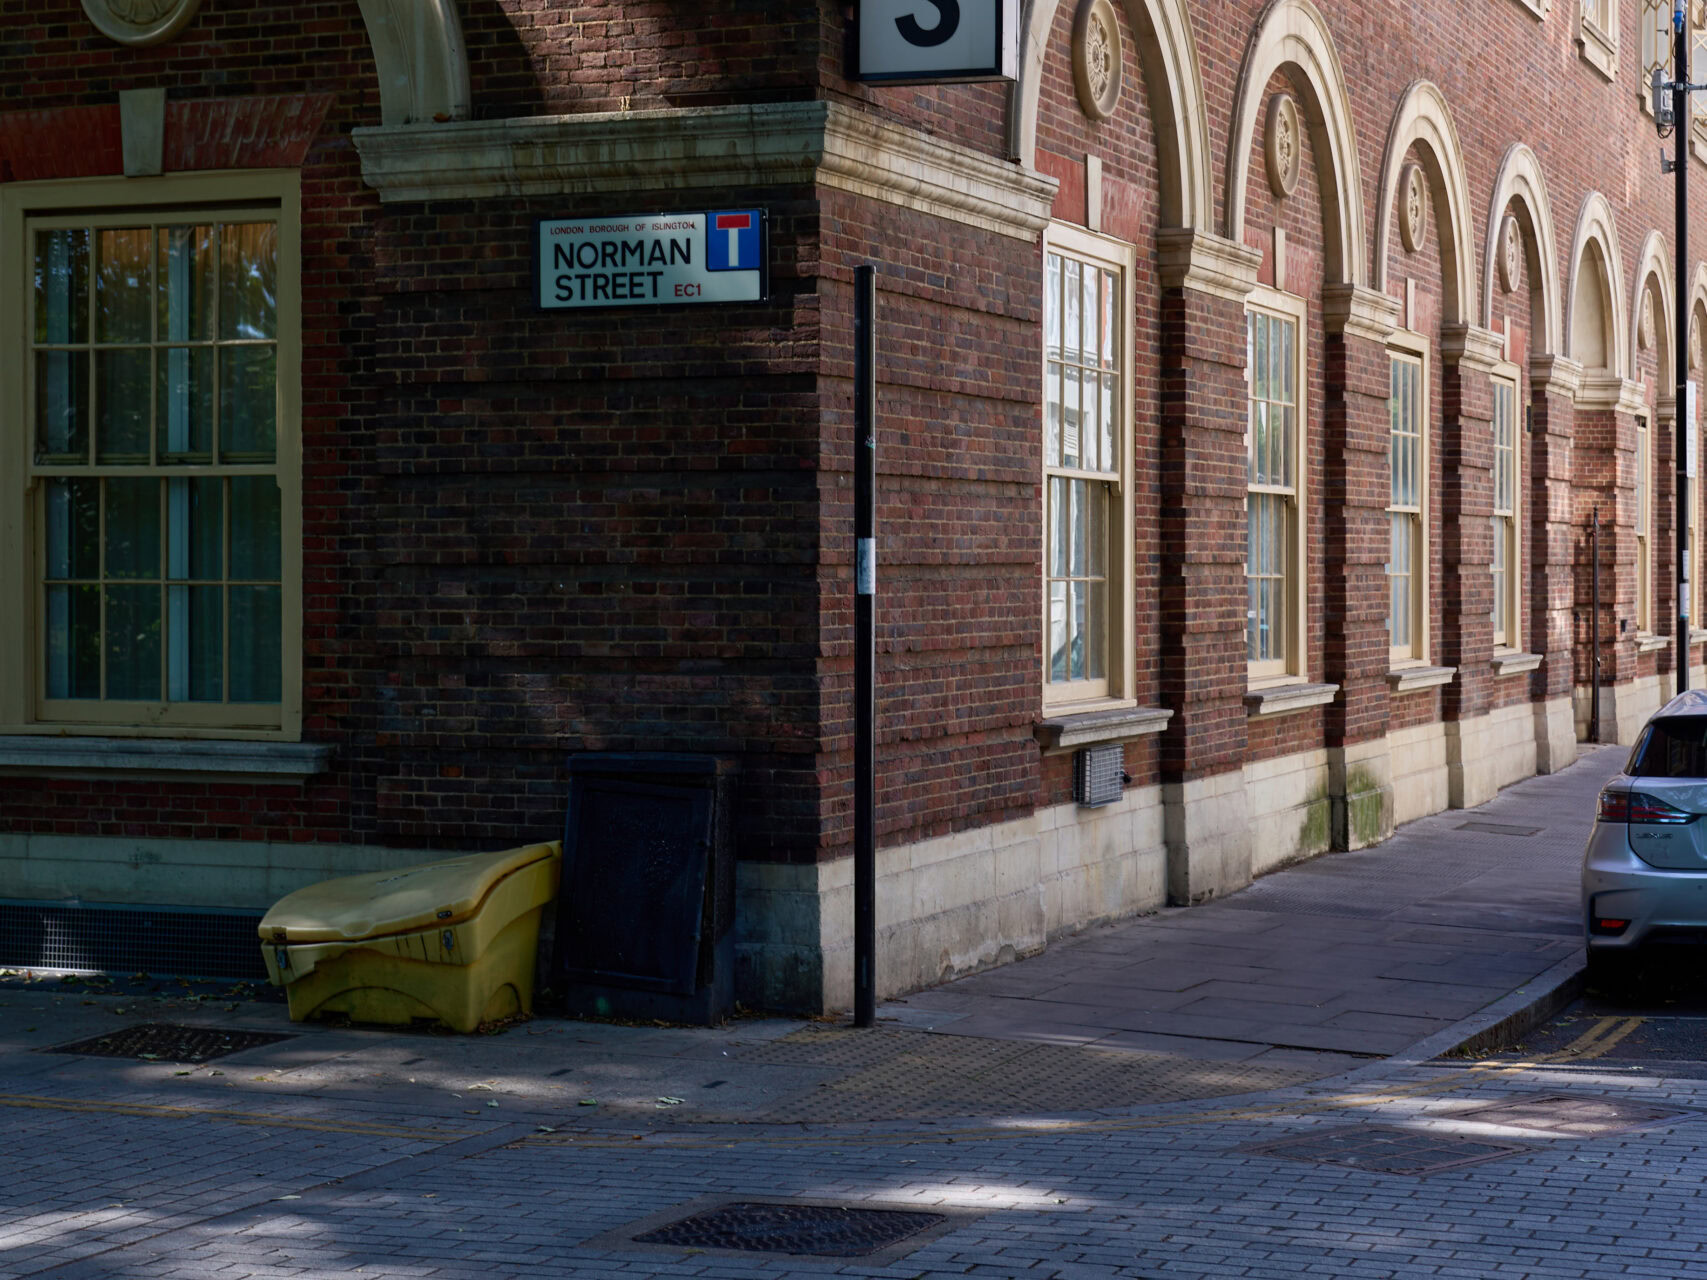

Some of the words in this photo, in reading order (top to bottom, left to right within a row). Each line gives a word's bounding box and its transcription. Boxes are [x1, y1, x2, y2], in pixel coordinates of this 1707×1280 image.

[550, 225, 584, 236] LONDON
[589, 223, 629, 234] BOROUGH
[635, 223, 646, 231] OF
[652, 221, 694, 231] ISLINGTON
[554, 237, 691, 269] NORMAN
[554, 271, 664, 301] STREET
[674, 283, 701, 297] EC1
